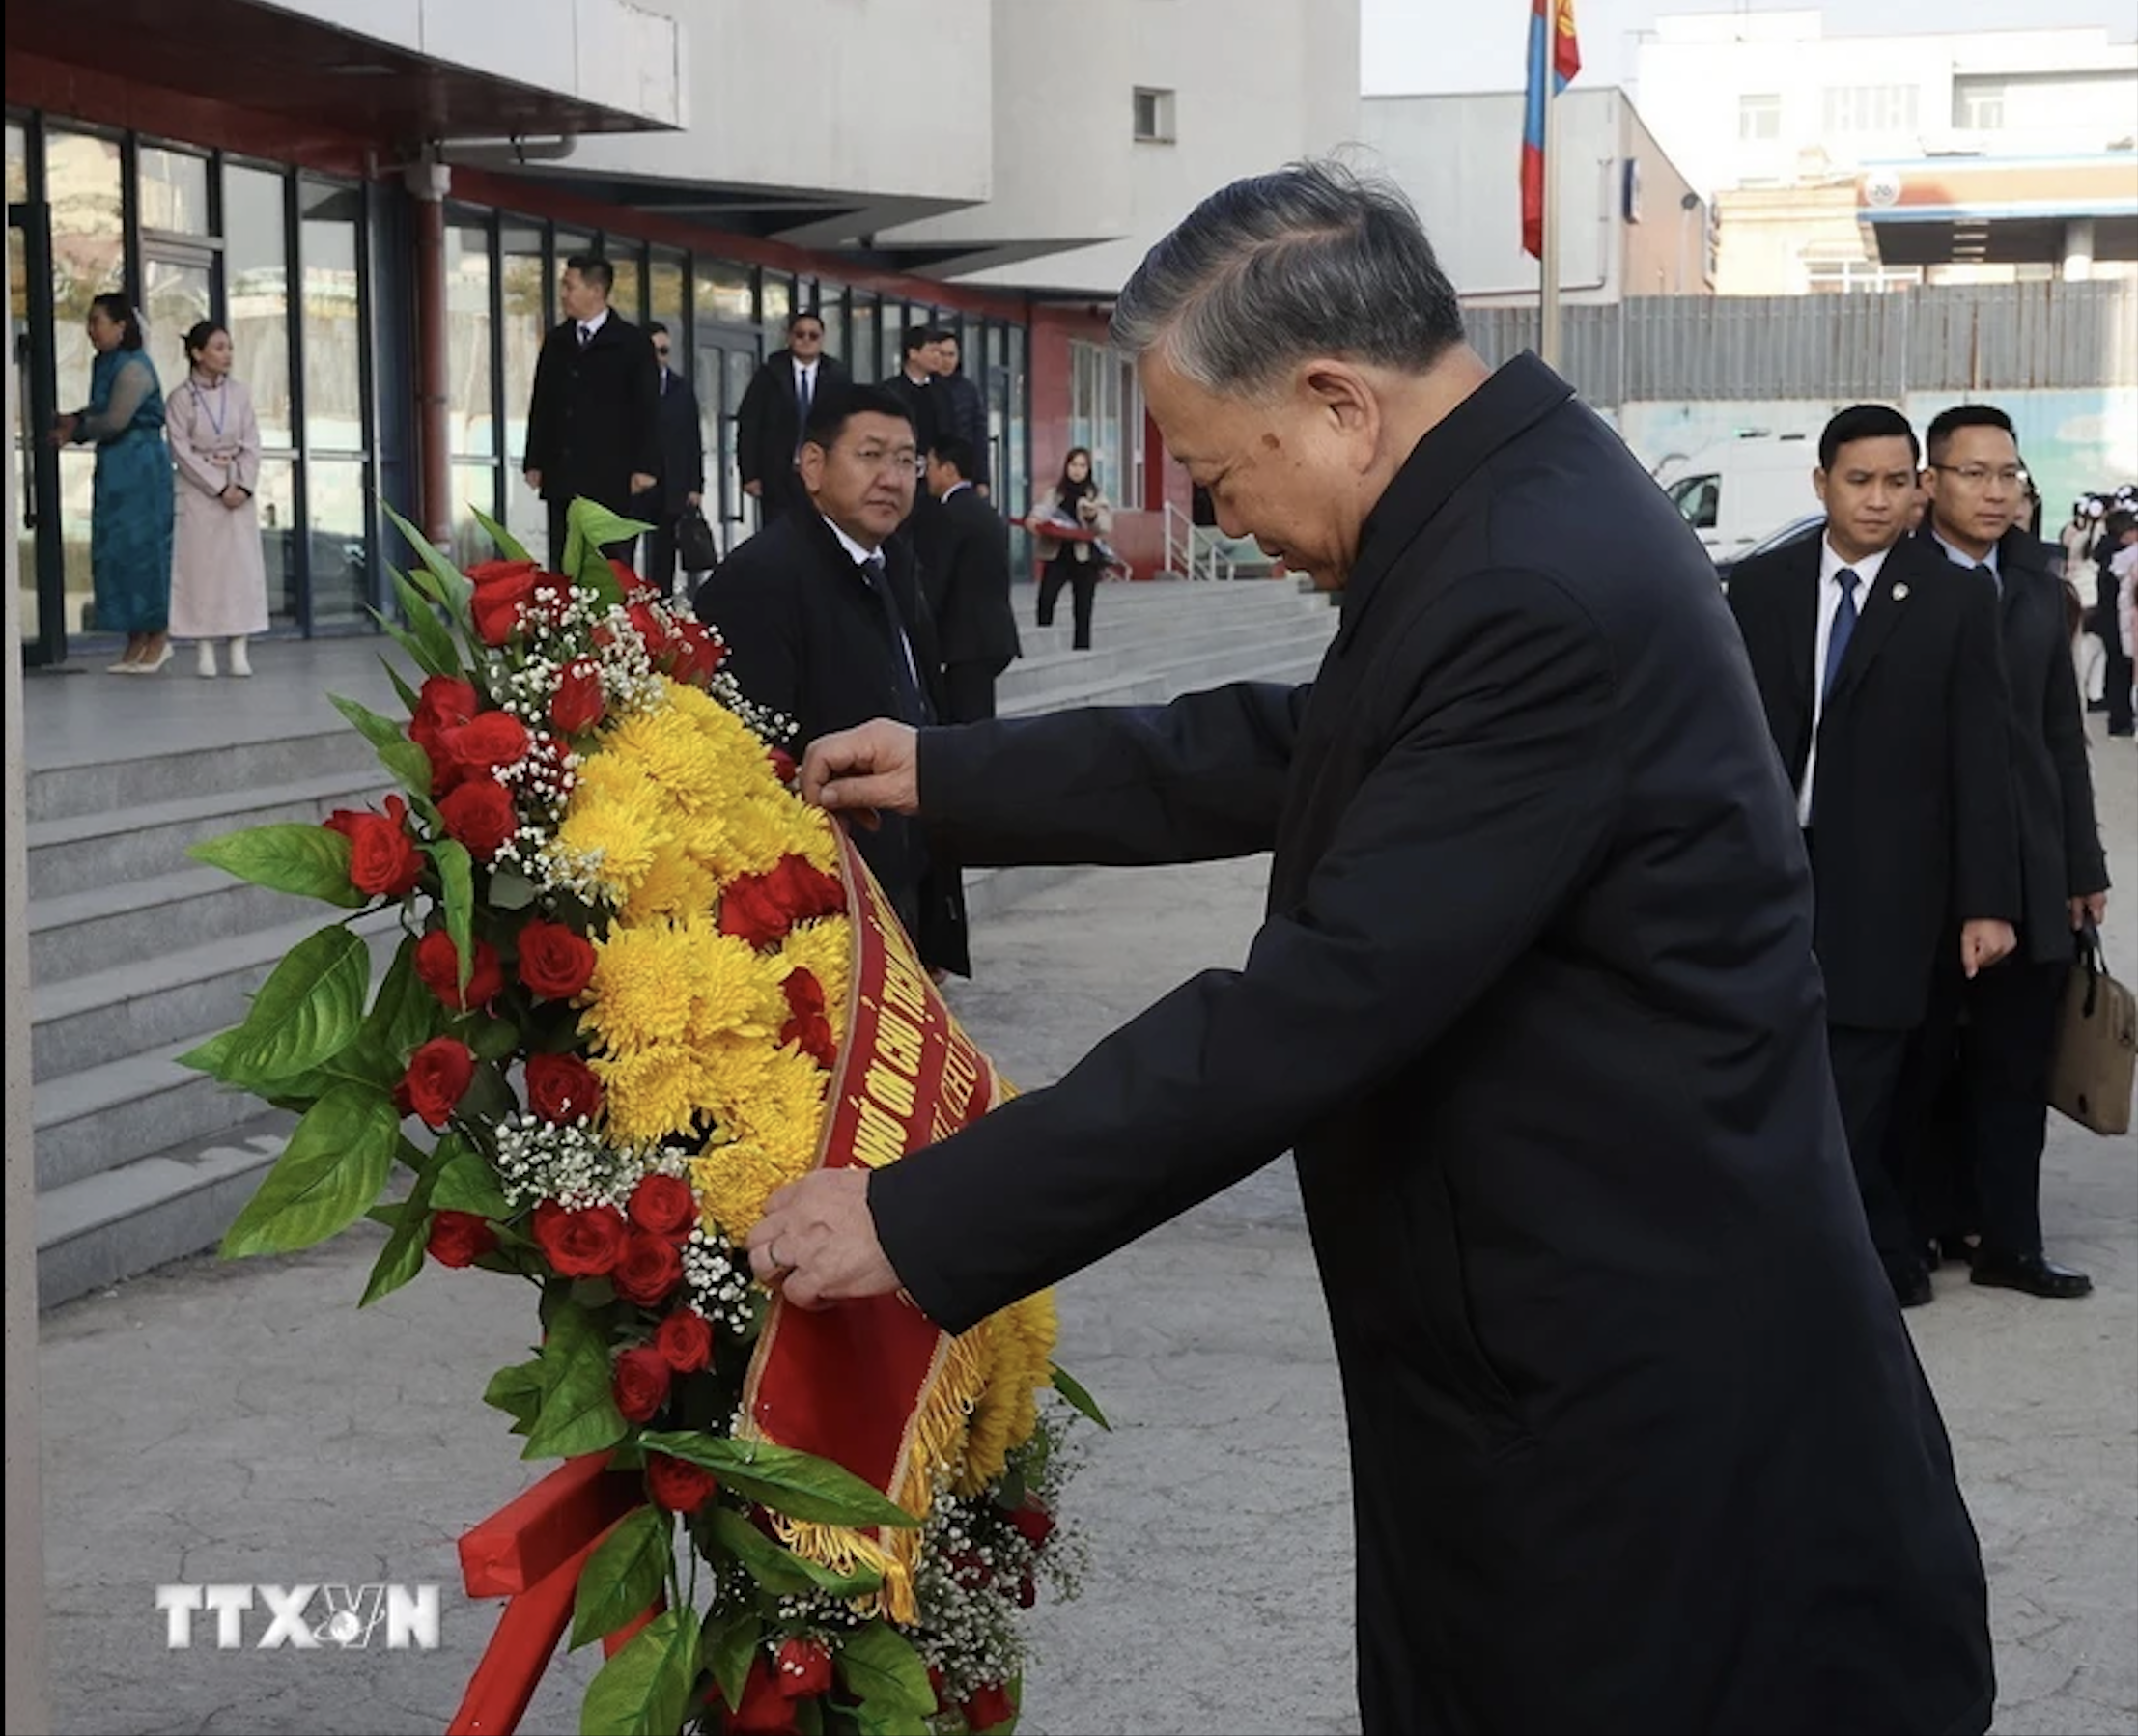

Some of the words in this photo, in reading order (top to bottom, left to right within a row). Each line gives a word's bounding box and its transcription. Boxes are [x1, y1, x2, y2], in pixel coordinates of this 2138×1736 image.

[859, 995, 924, 1077] CHỦ
[864, 1058, 916, 1118] ƠN
[933, 1032, 977, 1120] CHỦ
[848, 1094, 908, 1169] NHỚ
